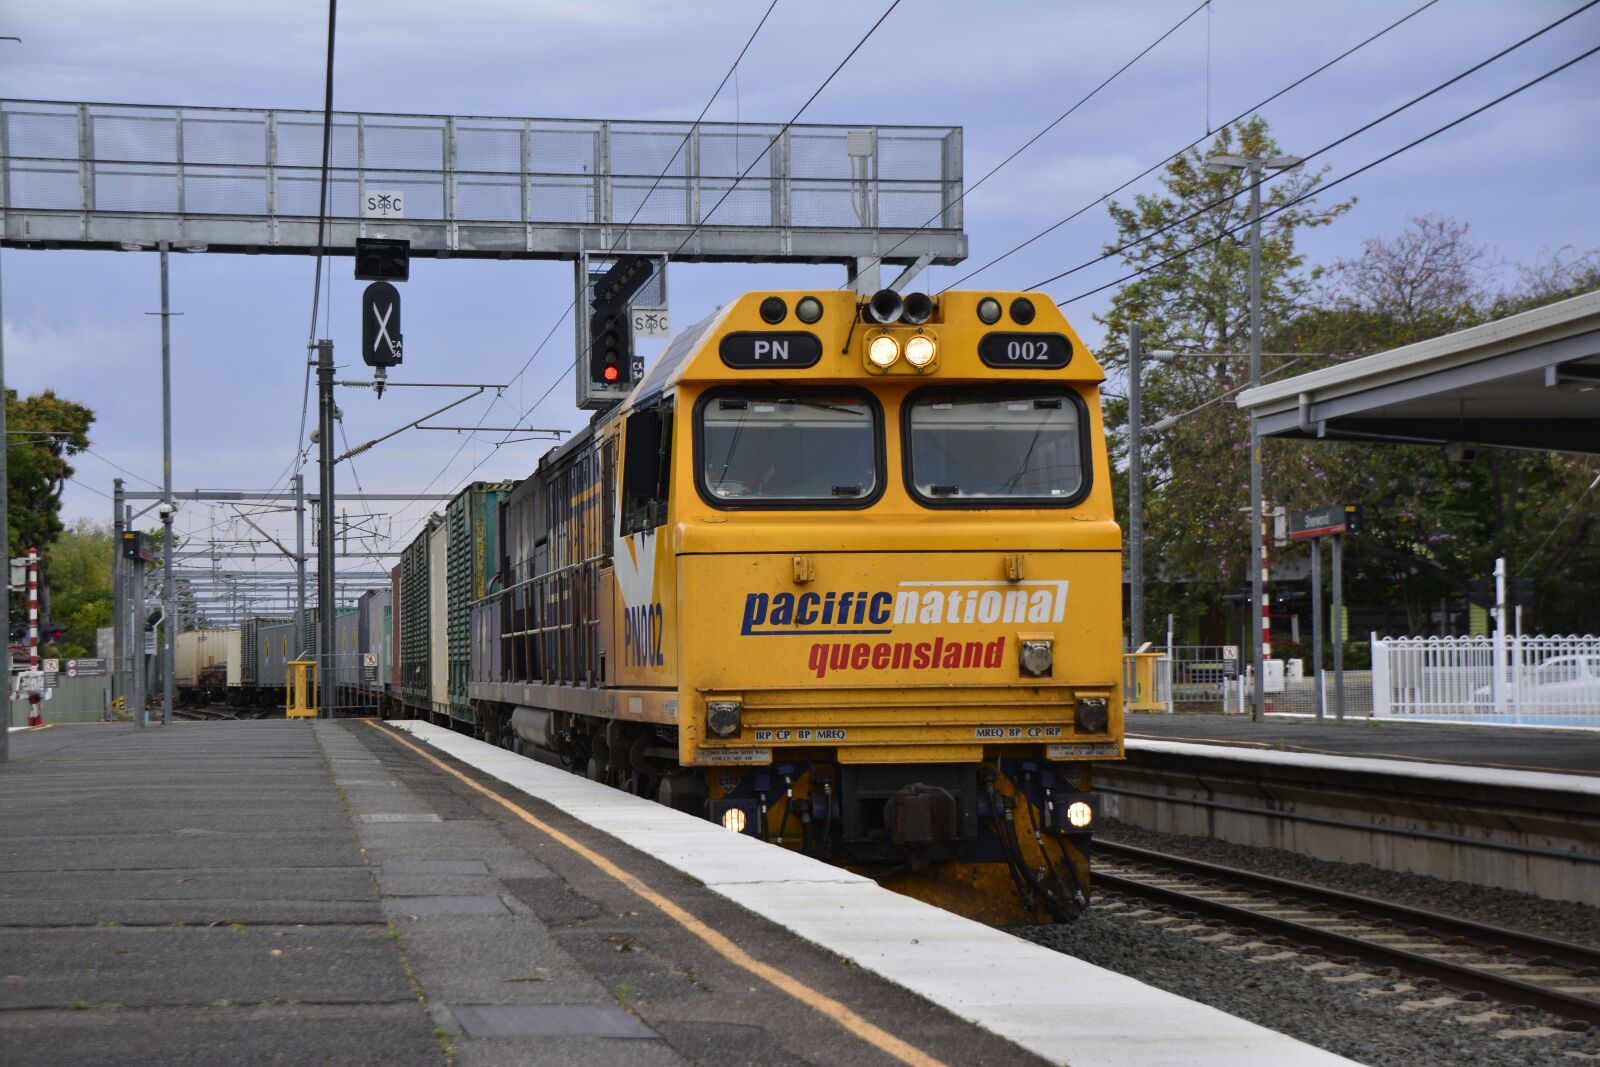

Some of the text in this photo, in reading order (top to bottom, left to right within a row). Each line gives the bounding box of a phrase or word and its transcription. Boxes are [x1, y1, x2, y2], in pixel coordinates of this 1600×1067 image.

[754, 340, 789, 360] PN
[1007, 341, 1049, 360] 002
[624, 602, 664, 668] PN002
[808, 636, 1006, 679] queensland
[756, 730, 846, 740] IRP CP BP MREQ
[976, 727, 1061, 738] MREQ BP CP IRP
